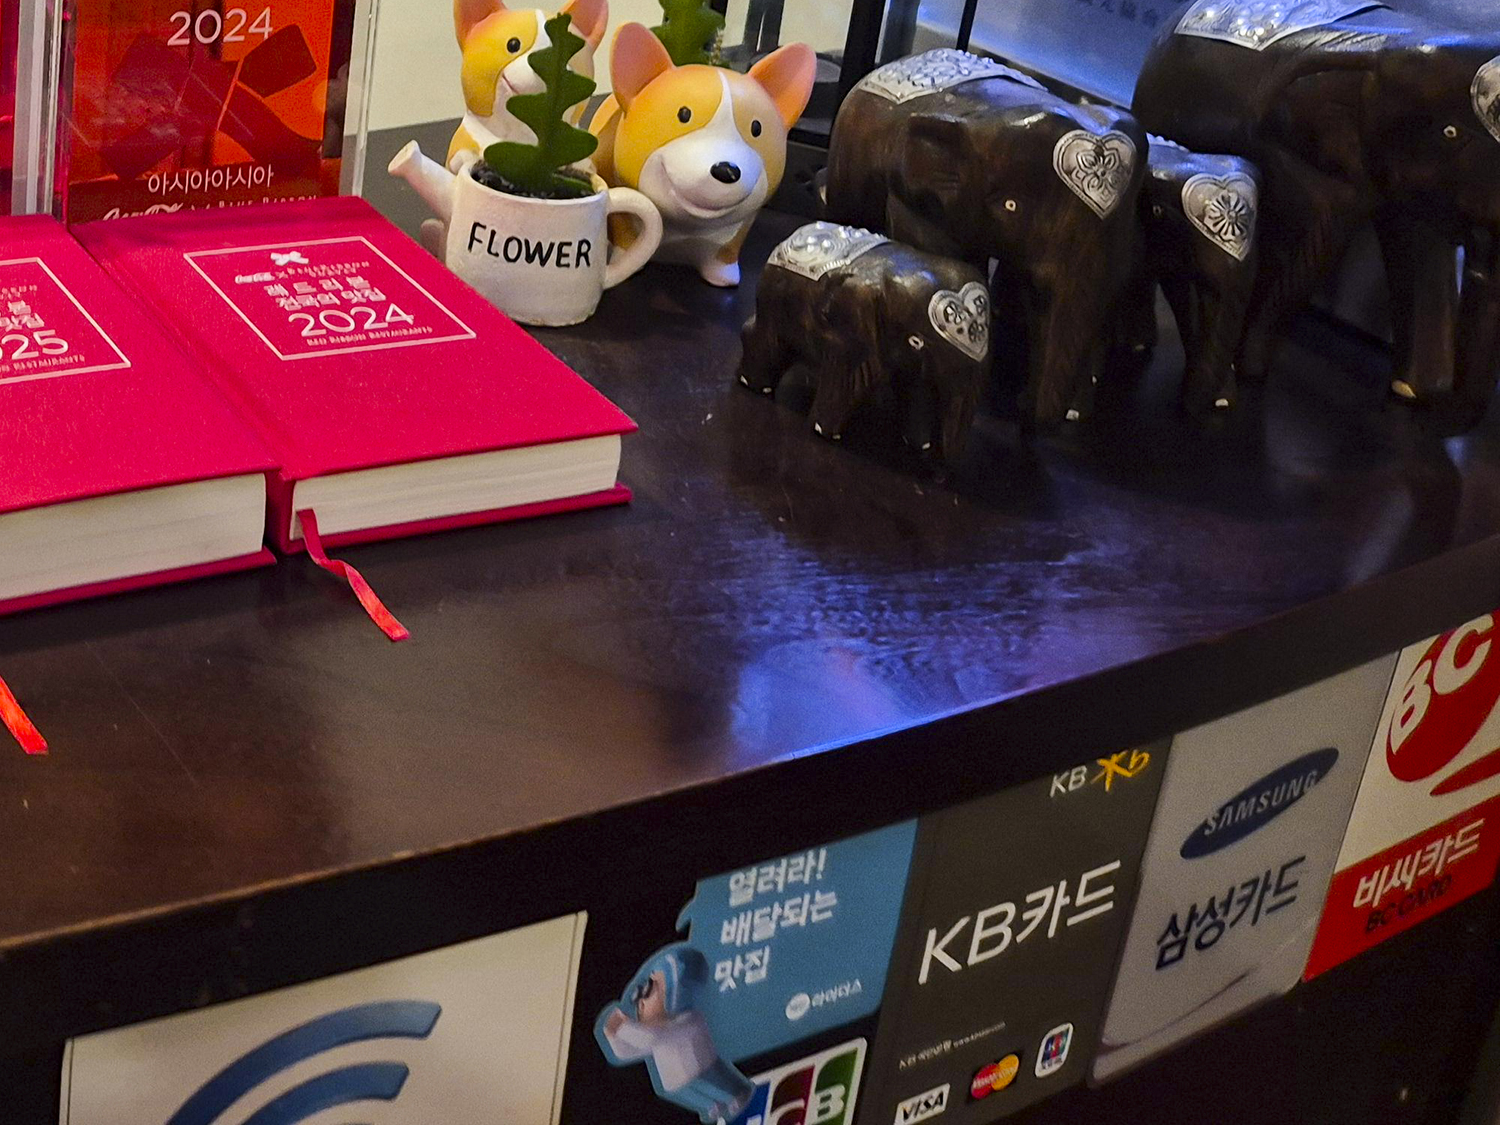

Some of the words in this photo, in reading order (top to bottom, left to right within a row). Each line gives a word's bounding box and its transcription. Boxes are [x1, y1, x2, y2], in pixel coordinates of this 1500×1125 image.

[167, 6, 273, 47] 2024
[148, 164, 274, 195] 아시아아시아
[467, 222, 592, 268] FLOWER
[288, 303, 414, 337] 2024
[1390, 613, 1495, 755] BC
[1050, 765, 1088, 797] KB
[1203, 769, 1318, 836] SAMSUNG
[1352, 817, 1486, 908] 비씨카드
[720, 889, 838, 947] 배달되는
[917, 859, 1122, 986] KB카드
[1155, 855, 1307, 971] 삼성카드
[714, 945, 771, 993] 맛집
[902, 1090, 945, 1122] VISA
